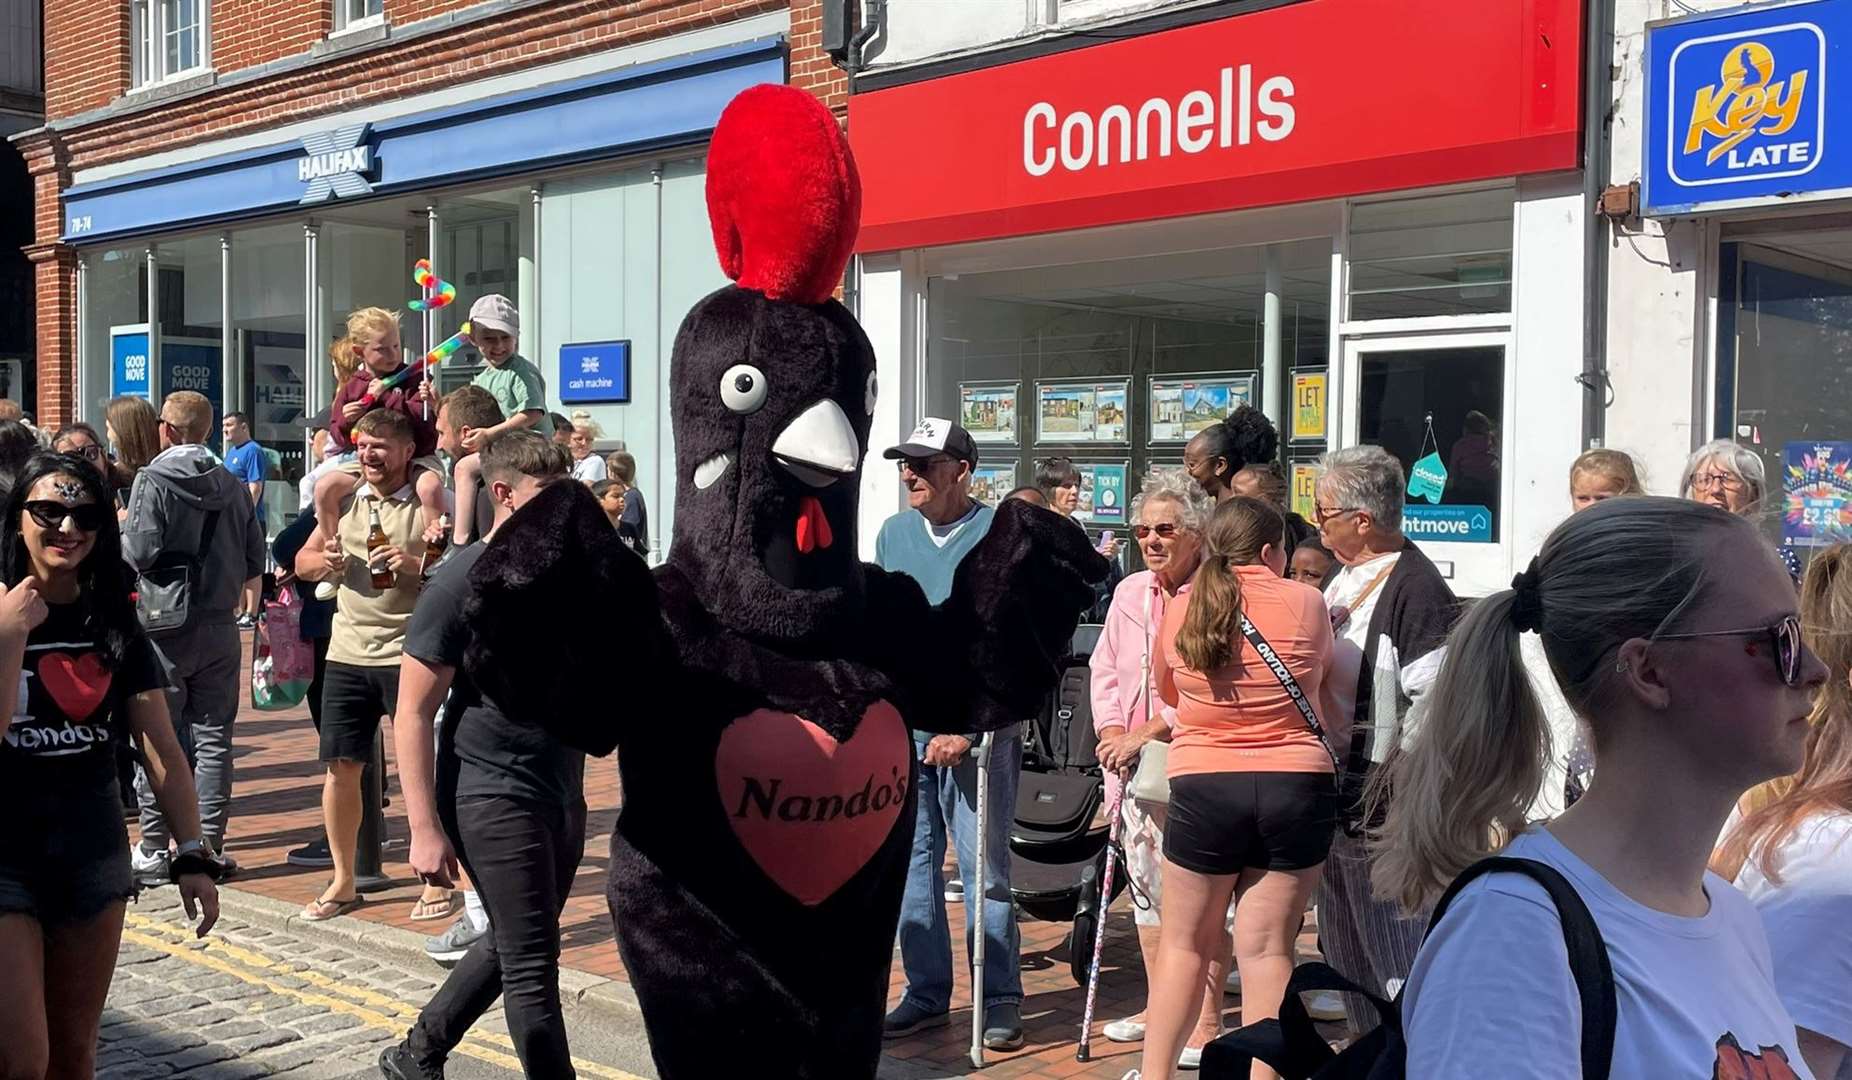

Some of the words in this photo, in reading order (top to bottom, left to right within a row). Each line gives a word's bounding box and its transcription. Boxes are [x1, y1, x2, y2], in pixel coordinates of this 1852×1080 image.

[1024, 63, 1296, 177] Connells
[1683, 69, 1809, 166] Key
[299, 145, 368, 180] HALIFAX
[1727, 142, 1810, 170] LATE
[125, 355, 146, 369] GOOD
[171, 365, 210, 378] GOOD
[125, 369, 145, 381] MOVE
[171, 377, 209, 390] MOVE
[569, 378, 584, 389] cash
[585, 377, 613, 388] machine
[256, 384, 304, 404] HALI
[1299, 386, 1320, 408] LET
[1414, 467, 1445, 485] closed
[1298, 476, 1313, 497] LE
[1402, 515, 1469, 534] htmove
[1256, 642, 1294, 686] HOLLAND
[1286, 682, 1302, 699] OF
[1297, 697, 1319, 730] HOUSE
[734, 765, 906, 822] Nando's
